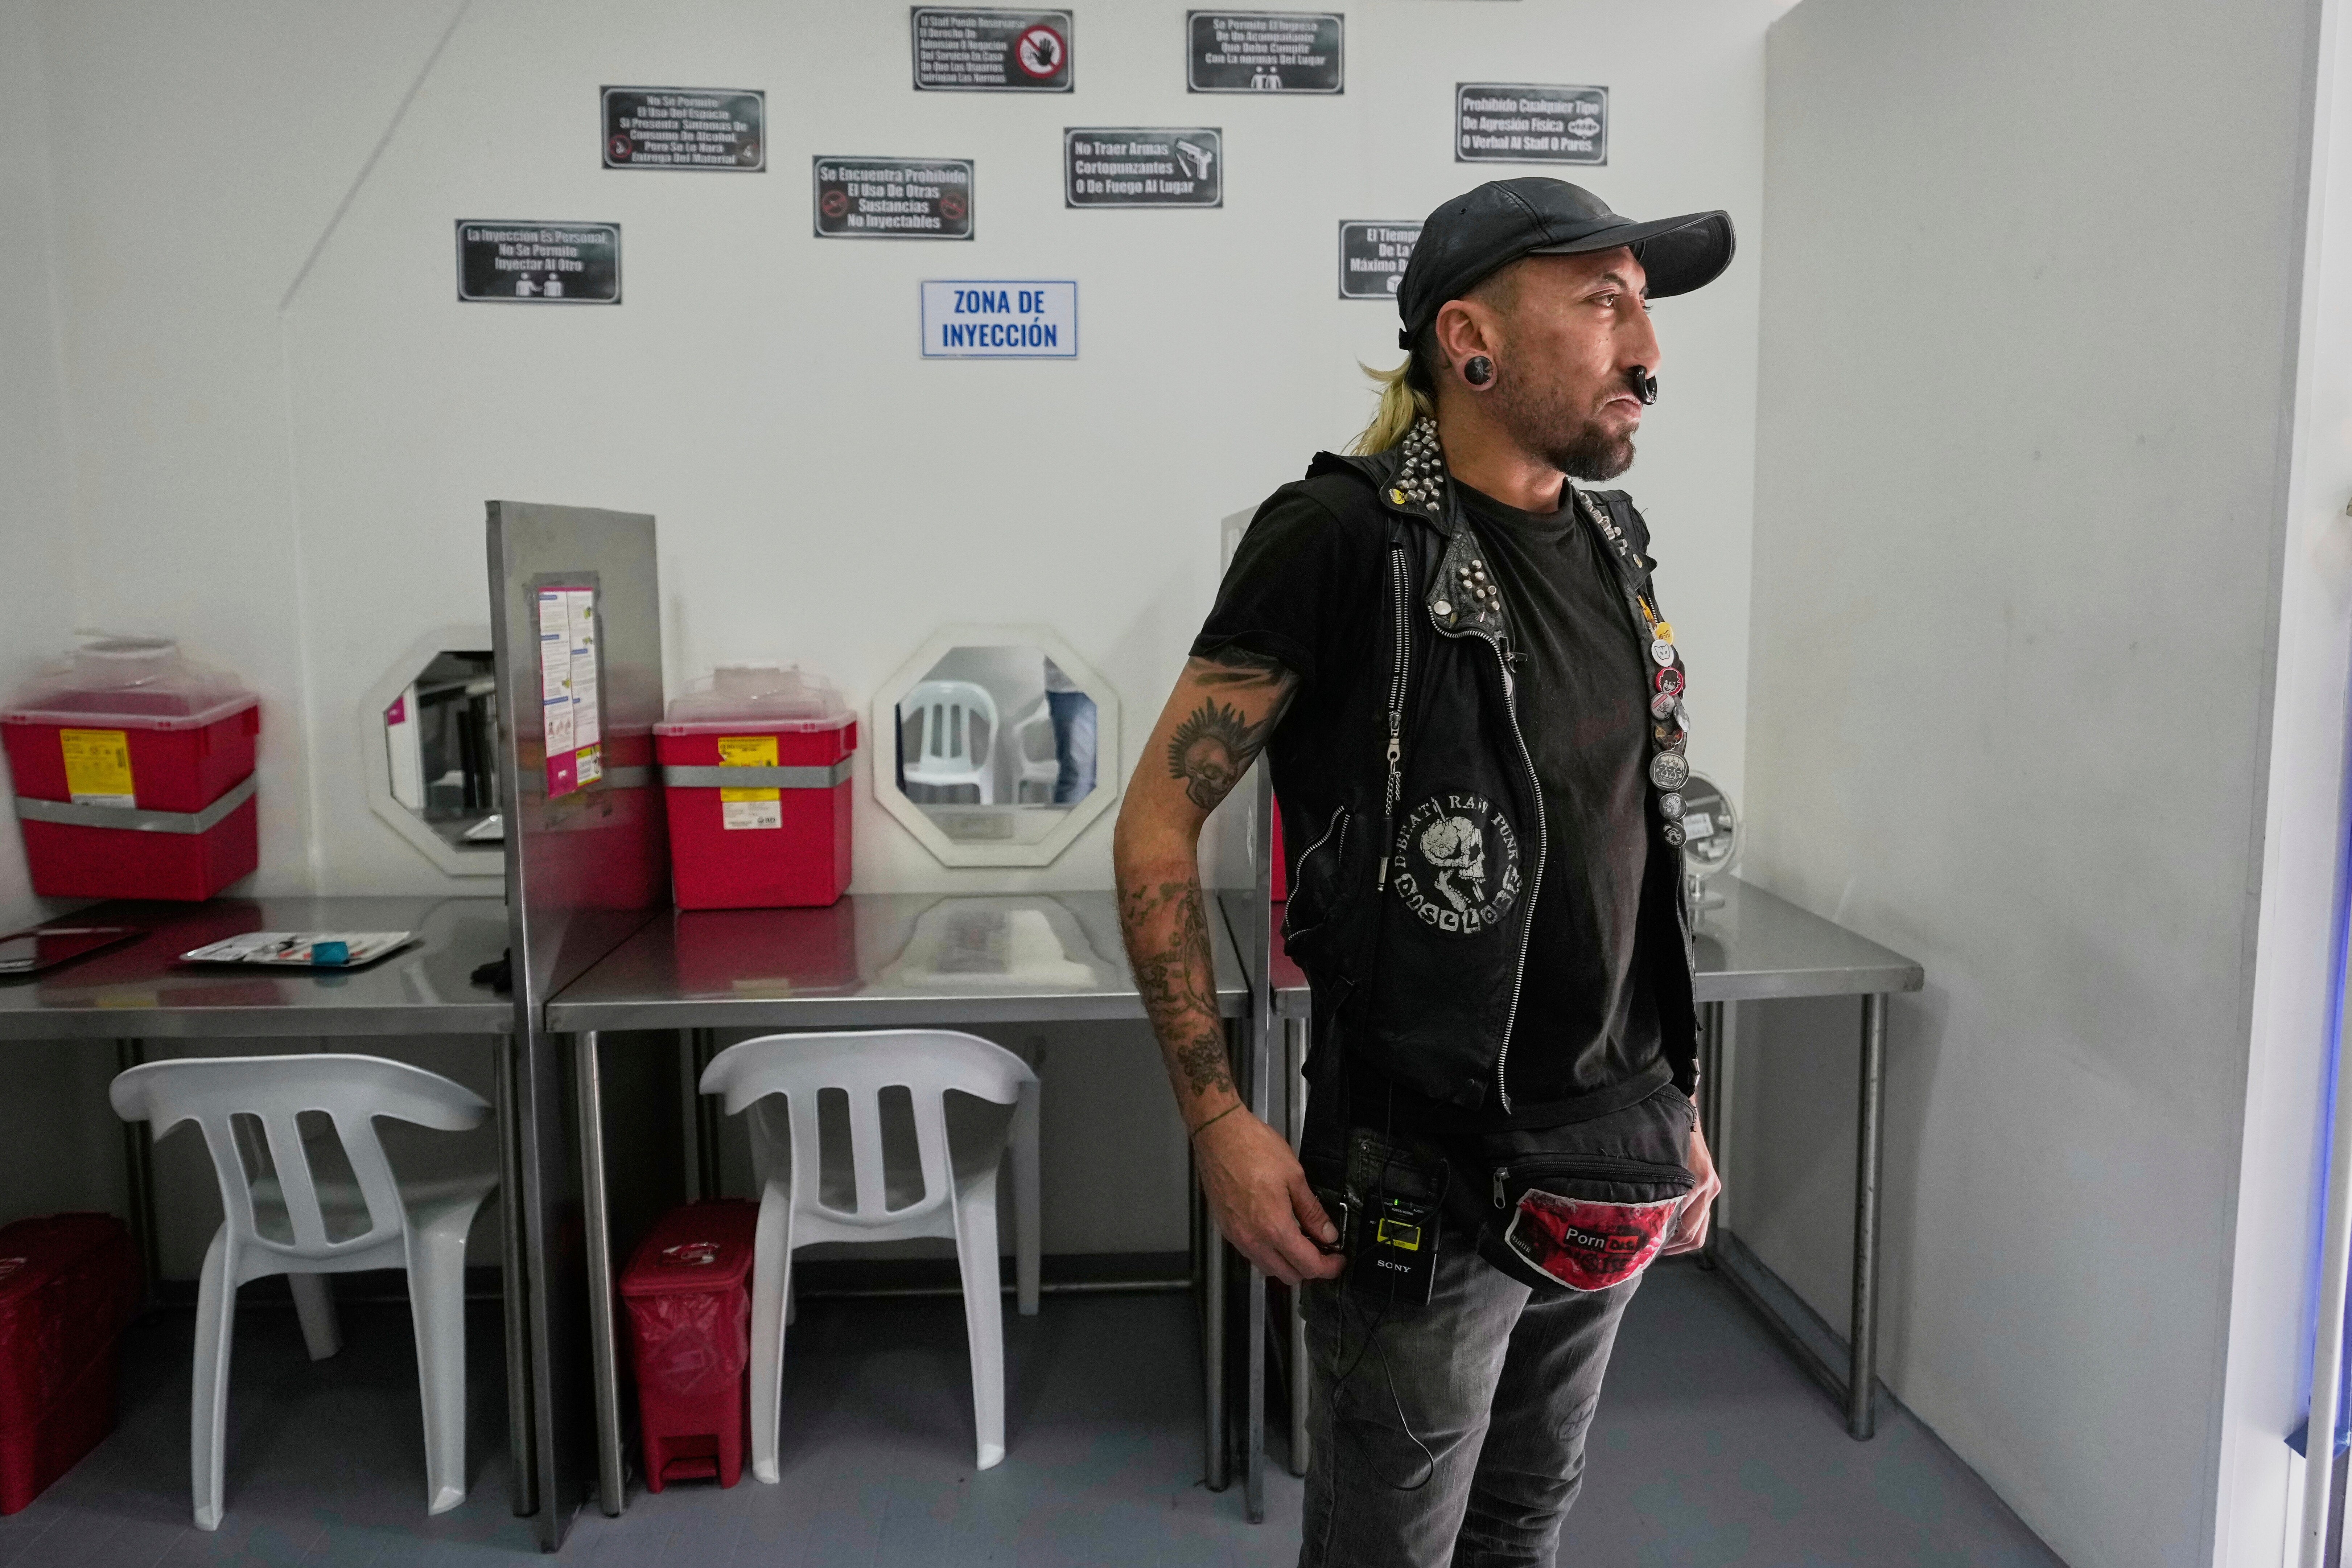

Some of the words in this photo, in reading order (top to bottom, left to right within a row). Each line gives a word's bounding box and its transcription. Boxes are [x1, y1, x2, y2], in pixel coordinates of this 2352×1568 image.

[1213, 19, 1225, 29] Se
[1228, 20, 1267, 30] Permite
[1269, 20, 1277, 30] El
[1279, 21, 1318, 31] Ingreso
[1216, 31, 1229, 41] De
[1231, 31, 1244, 41] Un
[1221, 42, 1241, 53] Que
[1243, 43, 1268, 53] Debe
[1270, 43, 1310, 54] Cumplir
[1205, 53, 1225, 63] Con
[1227, 54, 1238, 63] La
[1280, 55, 1296, 65] Del
[1298, 55, 1325, 66] Lugar
[1463, 98, 1517, 112] Prohibido
[1519, 99, 1573, 114] Cualquier
[1575, 100, 1599, 115] Tipo
[1463, 116, 1478, 130] De
[1075, 141, 1091, 155] No
[1093, 141, 1126, 156] Traer
[1129, 142, 1169, 155] Armas
[1462, 135, 1470, 149] O
[1472, 136, 1509, 149] Verbal
[1511, 136, 1521, 149] Al
[1523, 137, 1549, 150] Staff
[1551, 137, 1559, 150] O
[1561, 138, 1593, 151] Pares
[820, 167, 837, 181] Se
[839, 167, 902, 182] Encuentra
[905, 169, 966, 183] Prohibido
[1075, 160, 1173, 175] Cortopunzantes
[848, 183, 859, 197] El
[861, 184, 885, 197] Uso
[887, 184, 904, 197] De
[906, 184, 940, 198] Otras
[1076, 179, 1085, 193] O
[1087, 180, 1103, 193] De
[1105, 180, 1142, 195] Fuego
[1145, 180, 1157, 193] Al
[1159, 180, 1194, 194] Lugar
[858, 198, 930, 213] Sustancias
[847, 214, 864, 227] No
[866, 214, 941, 229] Inyectables
[467, 229, 479, 241] La
[540, 231, 553, 243] Es
[1367, 228, 1377, 242] El
[499, 244, 514, 256] No
[516, 244, 530, 256] Se
[532, 244, 578, 257] Permite
[1379, 243, 1395, 257] De
[1396, 243, 1409, 257] La
[495, 257, 543, 271] Inyectar
[545, 259, 556, 270] Al
[558, 259, 584, 272] Otro
[954, 291, 1010, 313] ZONA
[1019, 291, 1045, 313] DE
[943, 317, 1057, 347] INYECCIÓN
[1491, 812, 1518, 860] PUNK
[1566, 1228, 1605, 1248] Porn
[1377, 1260, 1411, 1273] SONY
